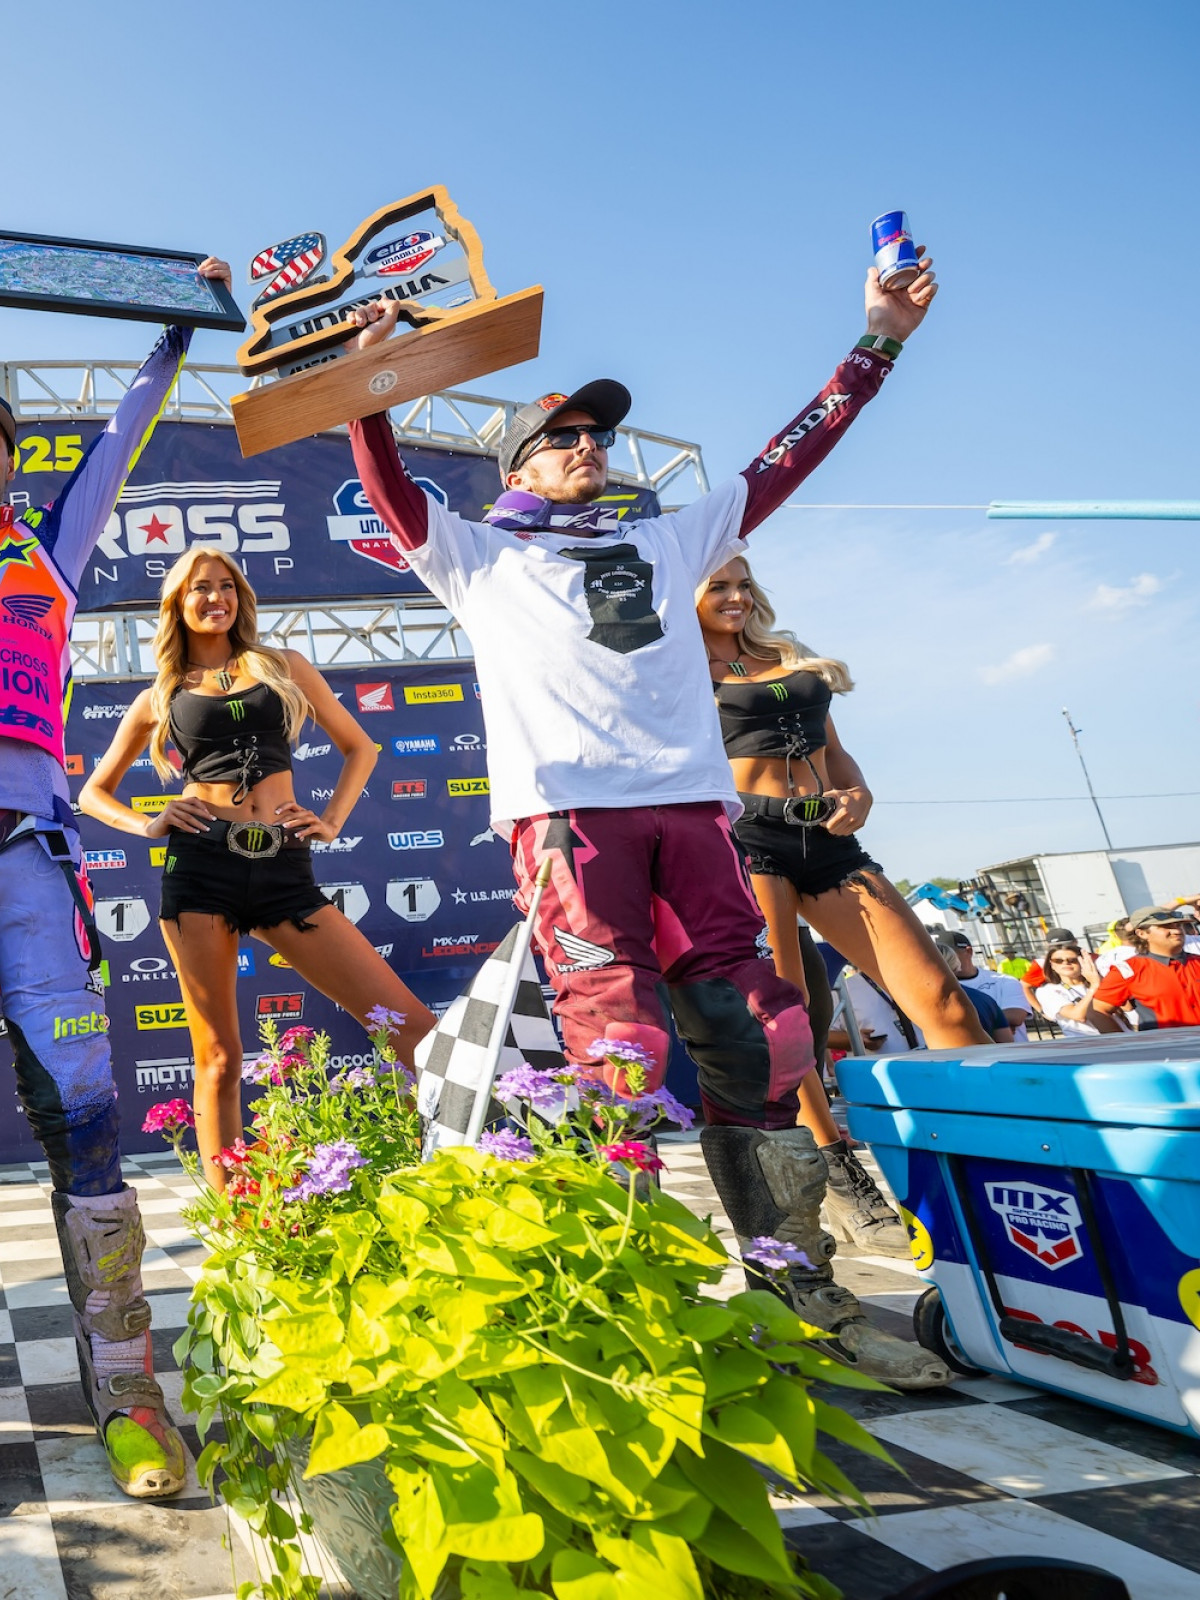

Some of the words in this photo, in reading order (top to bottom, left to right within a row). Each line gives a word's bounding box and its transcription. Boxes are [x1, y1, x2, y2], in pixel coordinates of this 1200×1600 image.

[376, 242, 403, 257] elf
[381, 246, 424, 266] UNADILLA
[413, 689, 454, 699] Insta360
[404, 738, 436, 748] YAMAHA
[394, 781, 425, 792] ETS
[390, 831, 443, 848] WPS
[86, 851, 124, 862] RTS
[469, 890, 489, 901] U.S.
[433, 935, 479, 946] MX-ATV
[259, 996, 303, 1011] ETS
[326, 1047, 383, 1069] eacock
[992, 1186, 1072, 1216] MX
[1012, 1208, 1059, 1219] SPORTS
[1009, 1214, 1029, 1225] PRO
[1030, 1217, 1068, 1232] RACING
